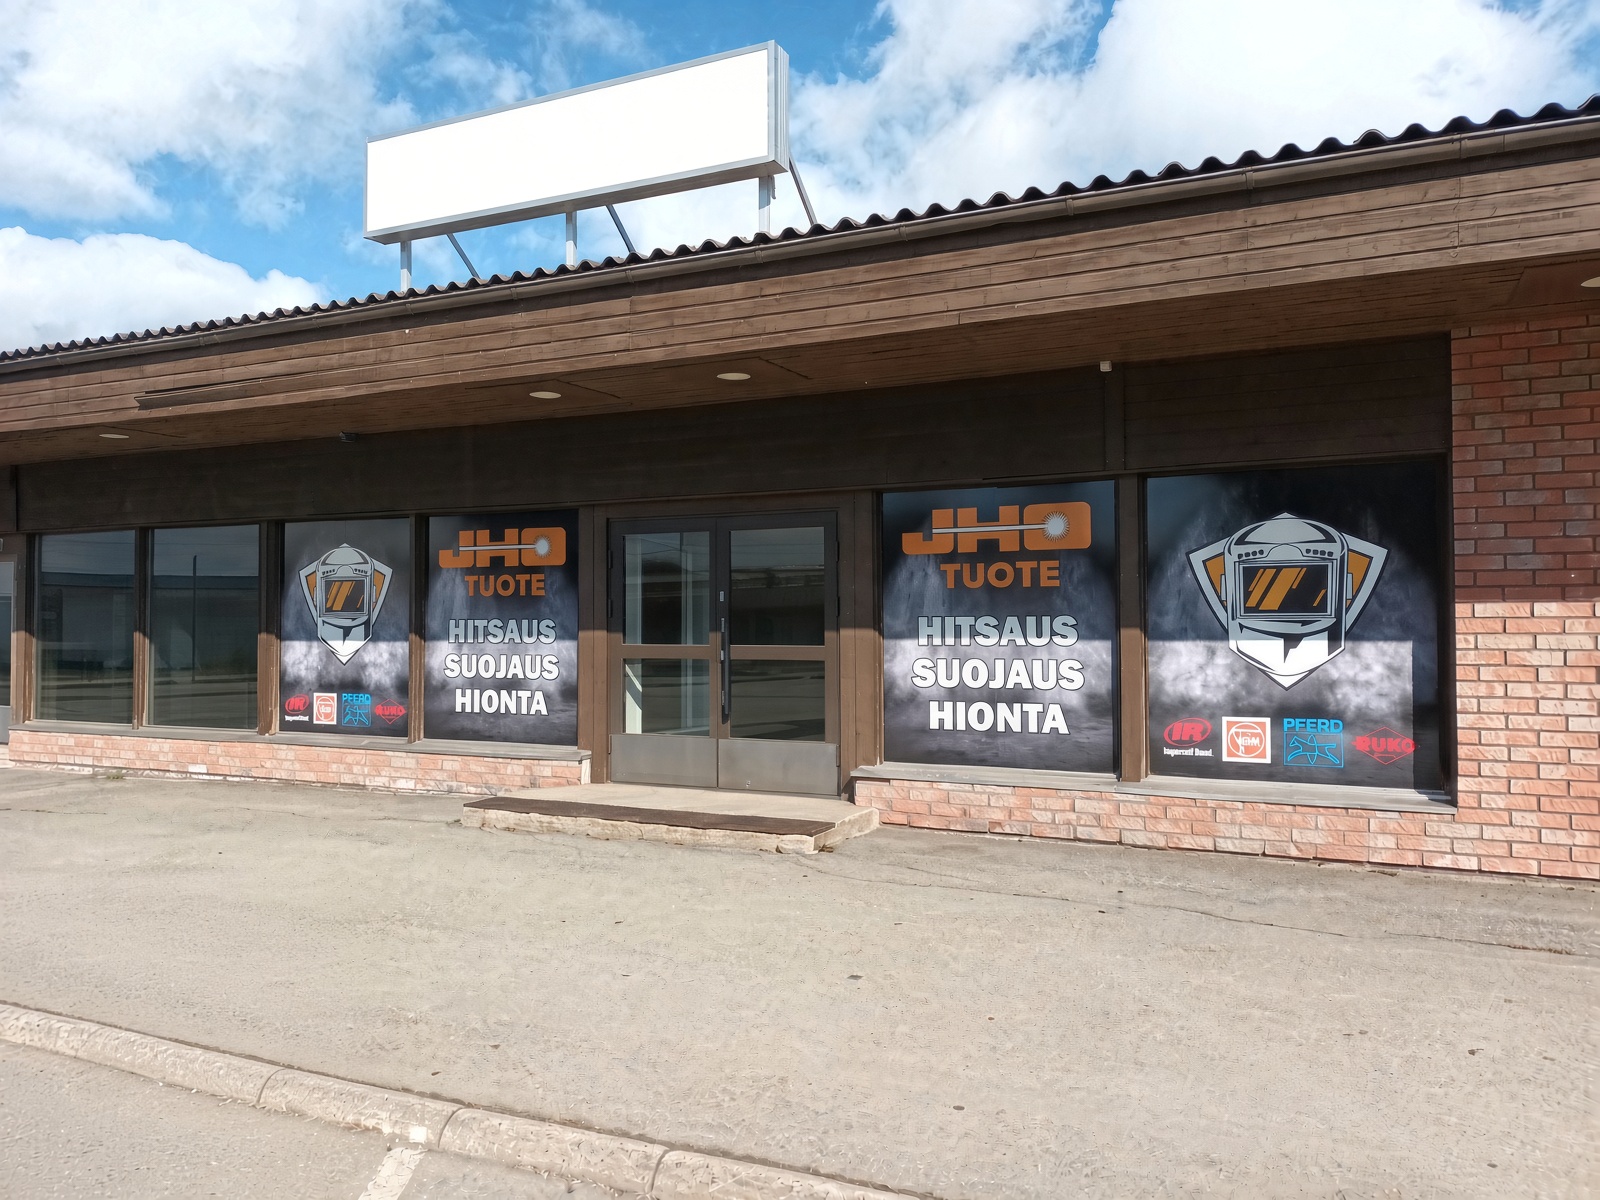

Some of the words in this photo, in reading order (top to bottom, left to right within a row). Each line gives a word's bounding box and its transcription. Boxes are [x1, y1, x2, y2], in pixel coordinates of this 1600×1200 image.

[902, 501, 1092, 555] JHO
[439, 526, 566, 568] JHO
[464, 573, 546, 597] TUOTE
[940, 560, 1061, 589] TUOTE
[448, 618, 557, 644] HITSAUS
[917, 614, 1079, 647] HITSAUS
[443, 653, 560, 680] SUOJAUS
[910, 657, 1086, 691] SUOJAUS
[454, 688, 549, 716] HIONTA
[928, 700, 1071, 735] HIONTA
[1171, 722, 1205, 741] IR
[1283, 718, 1343, 733] PFERD
[1355, 735, 1416, 752] RUKO
